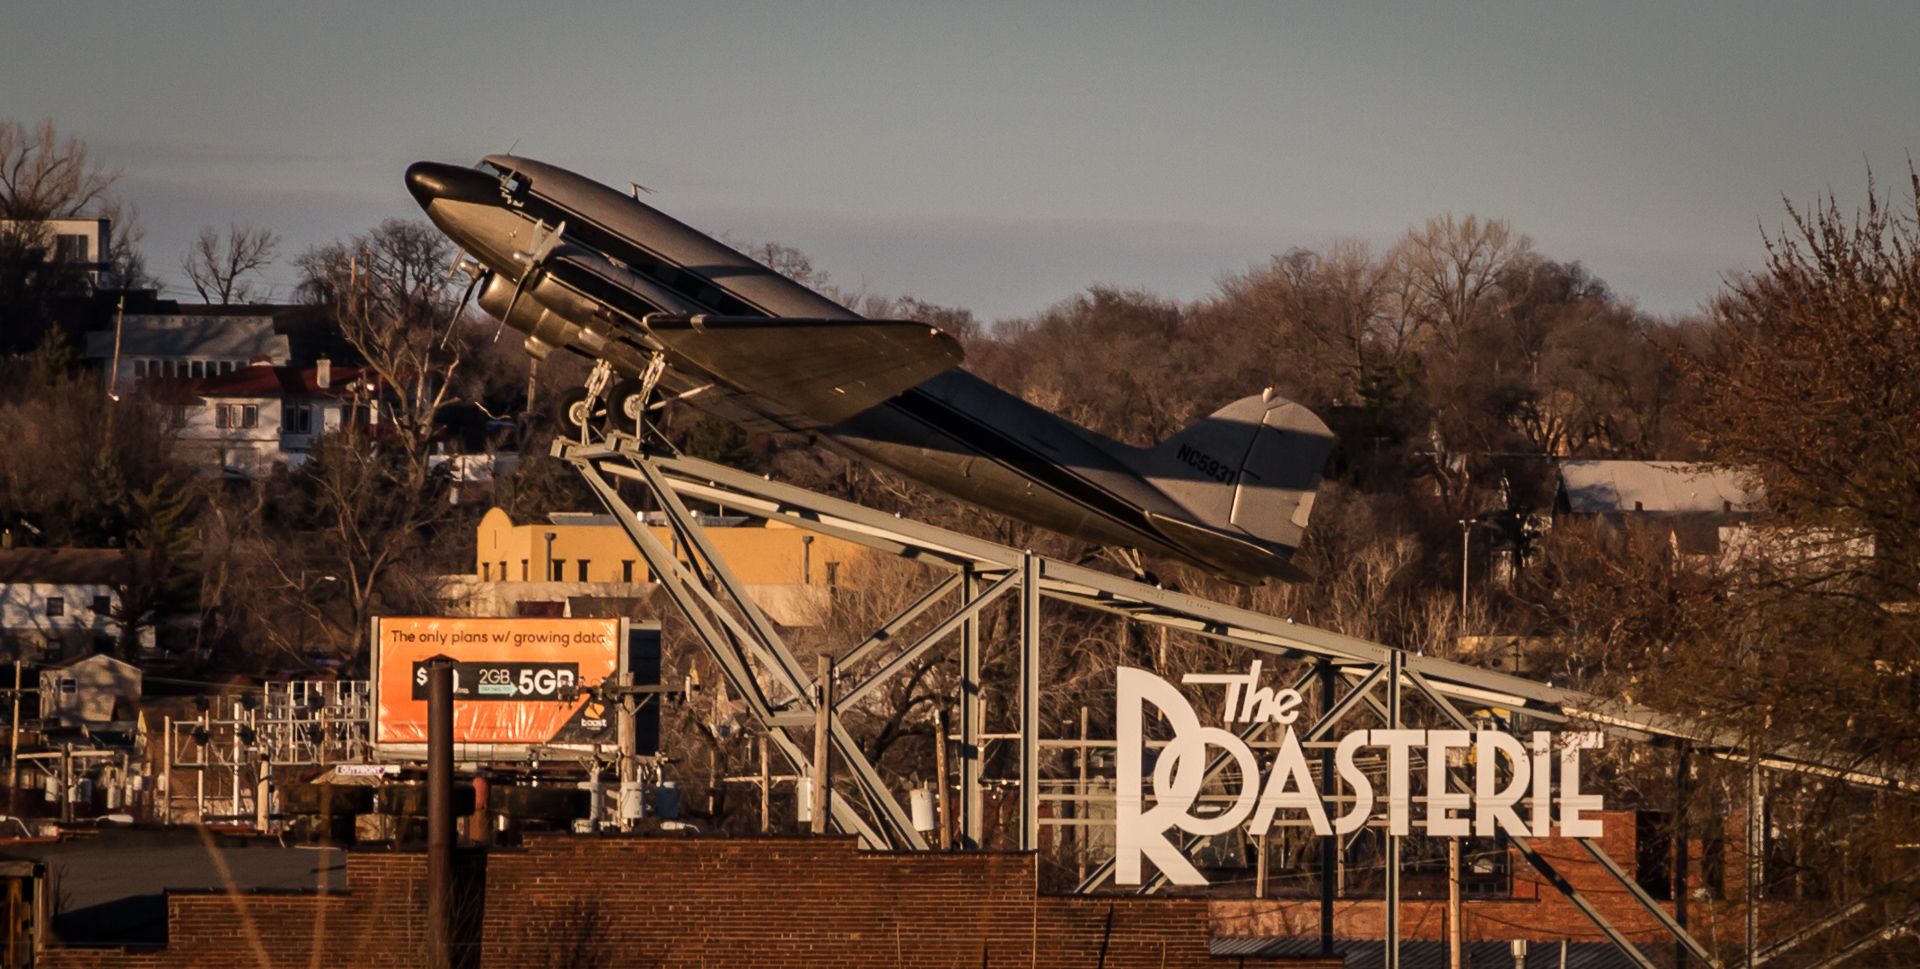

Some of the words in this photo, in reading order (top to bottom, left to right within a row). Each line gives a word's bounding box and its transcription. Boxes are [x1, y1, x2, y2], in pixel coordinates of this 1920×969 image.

[1176, 442, 1237, 487] NC5931
[391, 630, 416, 643] The
[418, 630, 448, 645] only
[451, 630, 489, 645] plans
[492, 630, 511, 643] w/
[513, 630, 570, 648] growing
[573, 630, 606, 644] data
[479, 668, 511, 684] 2GB
[1182, 659, 1302, 724] The
[1115, 665, 1604, 886] ROASTERIE
